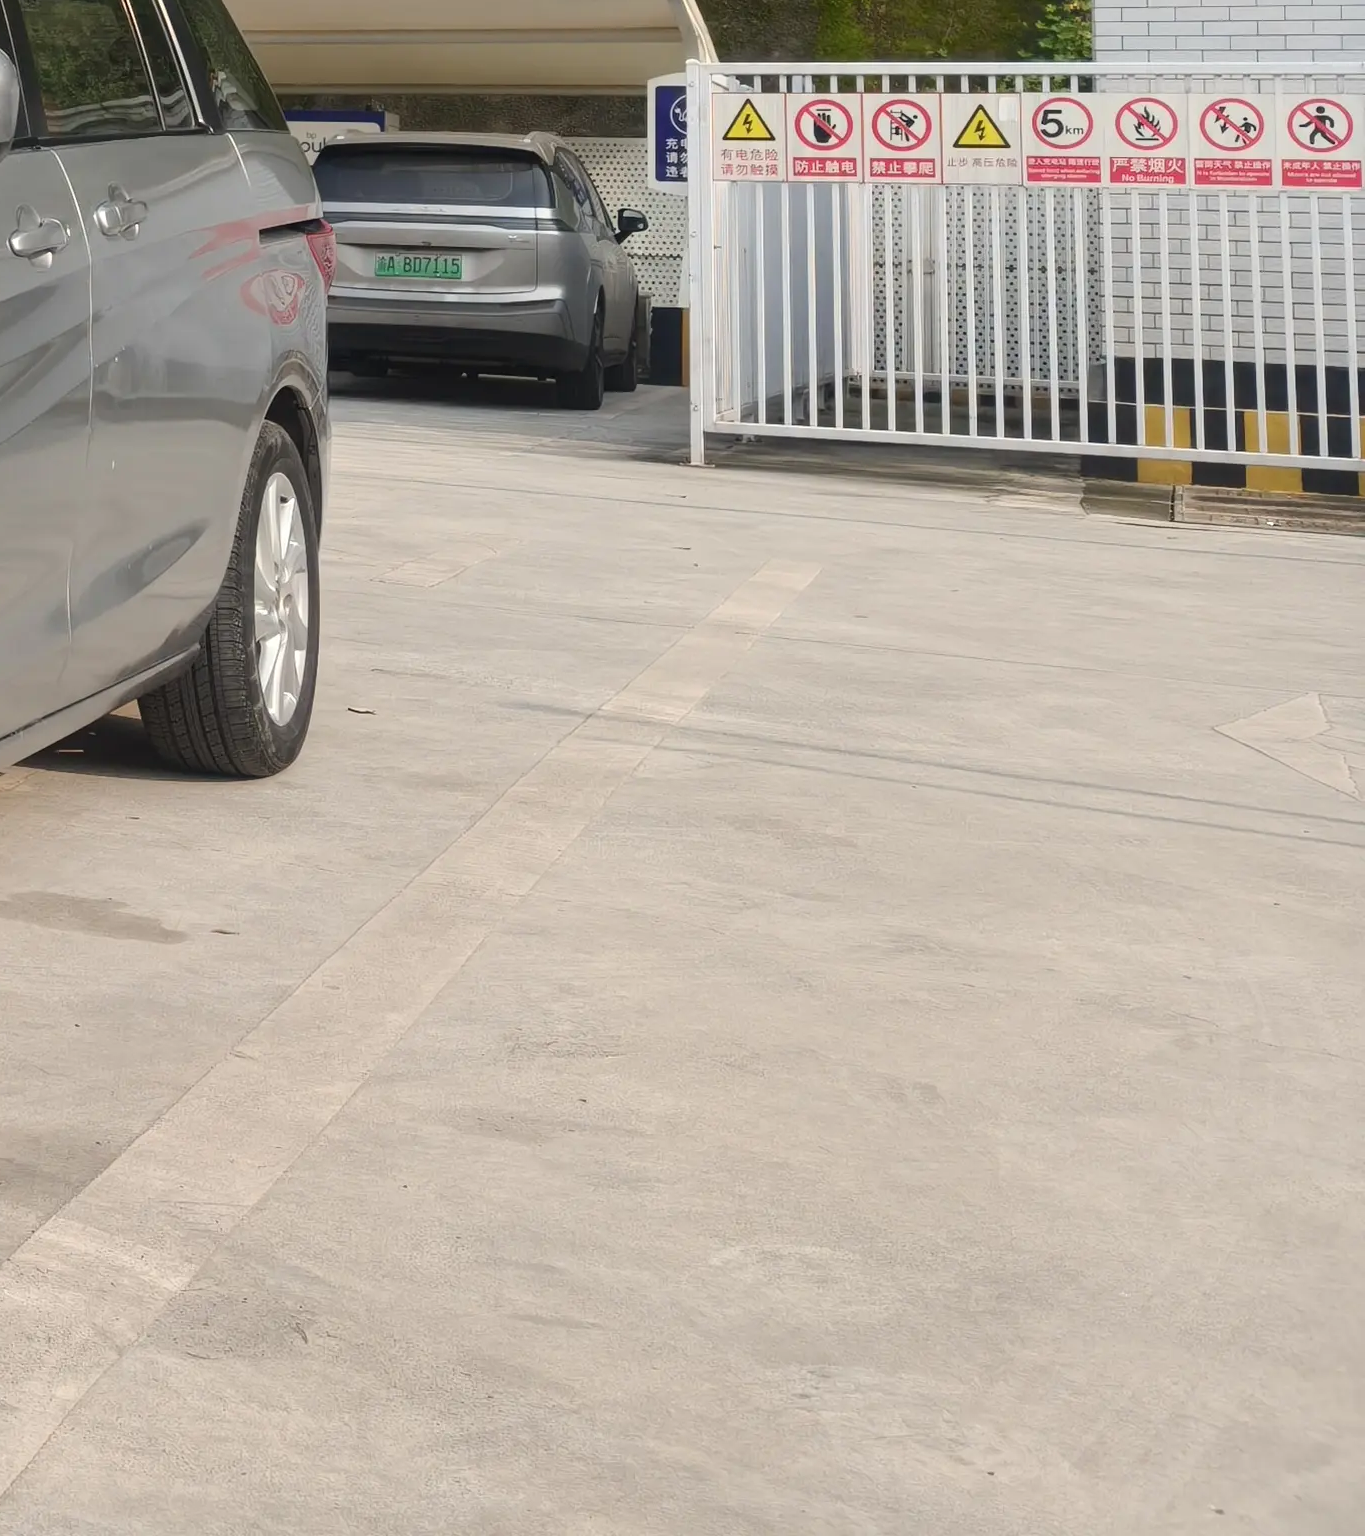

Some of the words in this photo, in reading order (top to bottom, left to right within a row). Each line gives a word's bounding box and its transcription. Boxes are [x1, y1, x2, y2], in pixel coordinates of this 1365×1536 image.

[721, 148, 779, 162] 有电危险
[721, 163, 779, 178] 请勿触摸
[794, 160, 856, 175] 防止触电
[871, 161, 935, 175] 禁止攀爬
[1111, 157, 1184, 173] 严禁烟火
[1121, 173, 1135, 182] No
[1136, 173, 1175, 184] Burning
